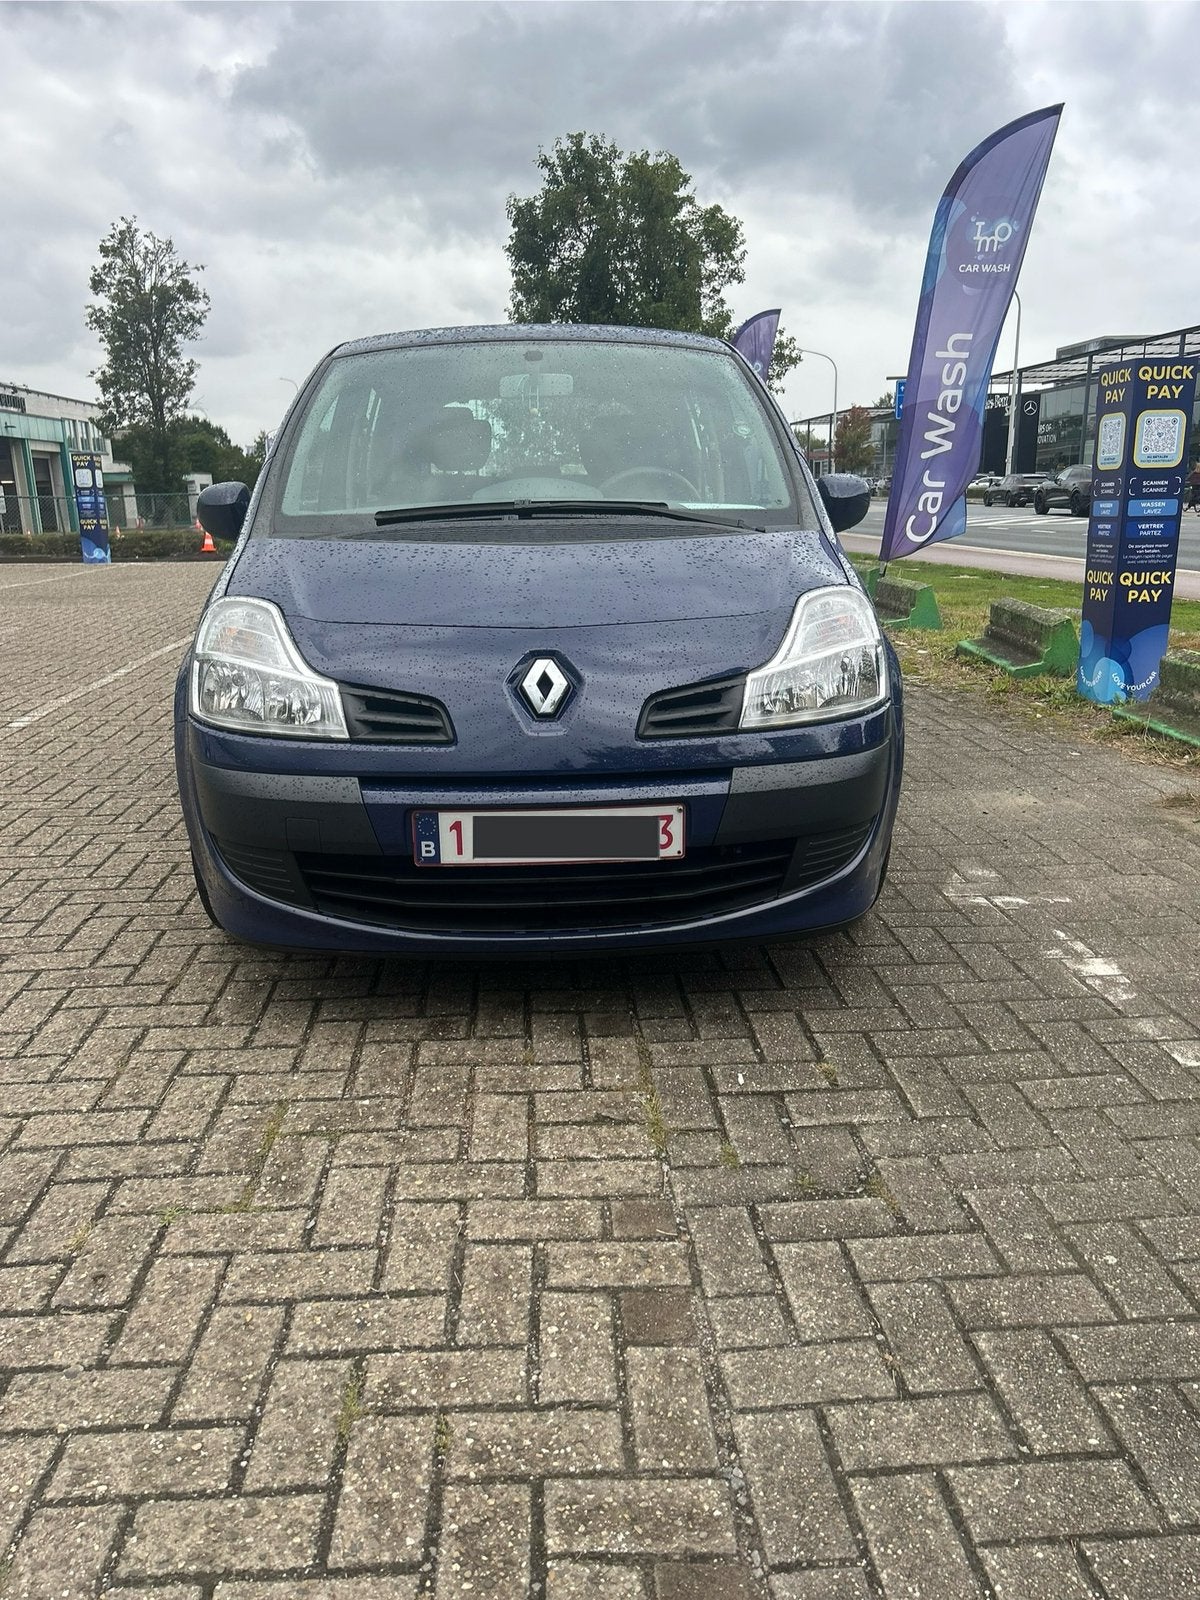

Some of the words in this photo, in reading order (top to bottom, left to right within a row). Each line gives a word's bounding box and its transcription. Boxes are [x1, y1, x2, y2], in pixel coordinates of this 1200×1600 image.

[958, 264, 979, 273] CAR
[981, 263, 1011, 273] WASH
[1101, 368, 1132, 387] QUICK
[1138, 365, 1195, 382] QUICK
[920, 332, 973, 460] Wash
[1105, 388, 1125, 404] PAY
[1146, 385, 1184, 400] PAY
[905, 470, 945, 544] Car
[1087, 570, 1114, 585] QUICK
[1119, 572, 1172, 587] QUICK
[1090, 588, 1108, 602] PAY
[1128, 590, 1163, 603] PAY
[1112, 672, 1126, 690] LOVE
[1126, 683, 1146, 691] YOUR
[1146, 671, 1157, 685] CAR
[421, 841, 435, 857] B
